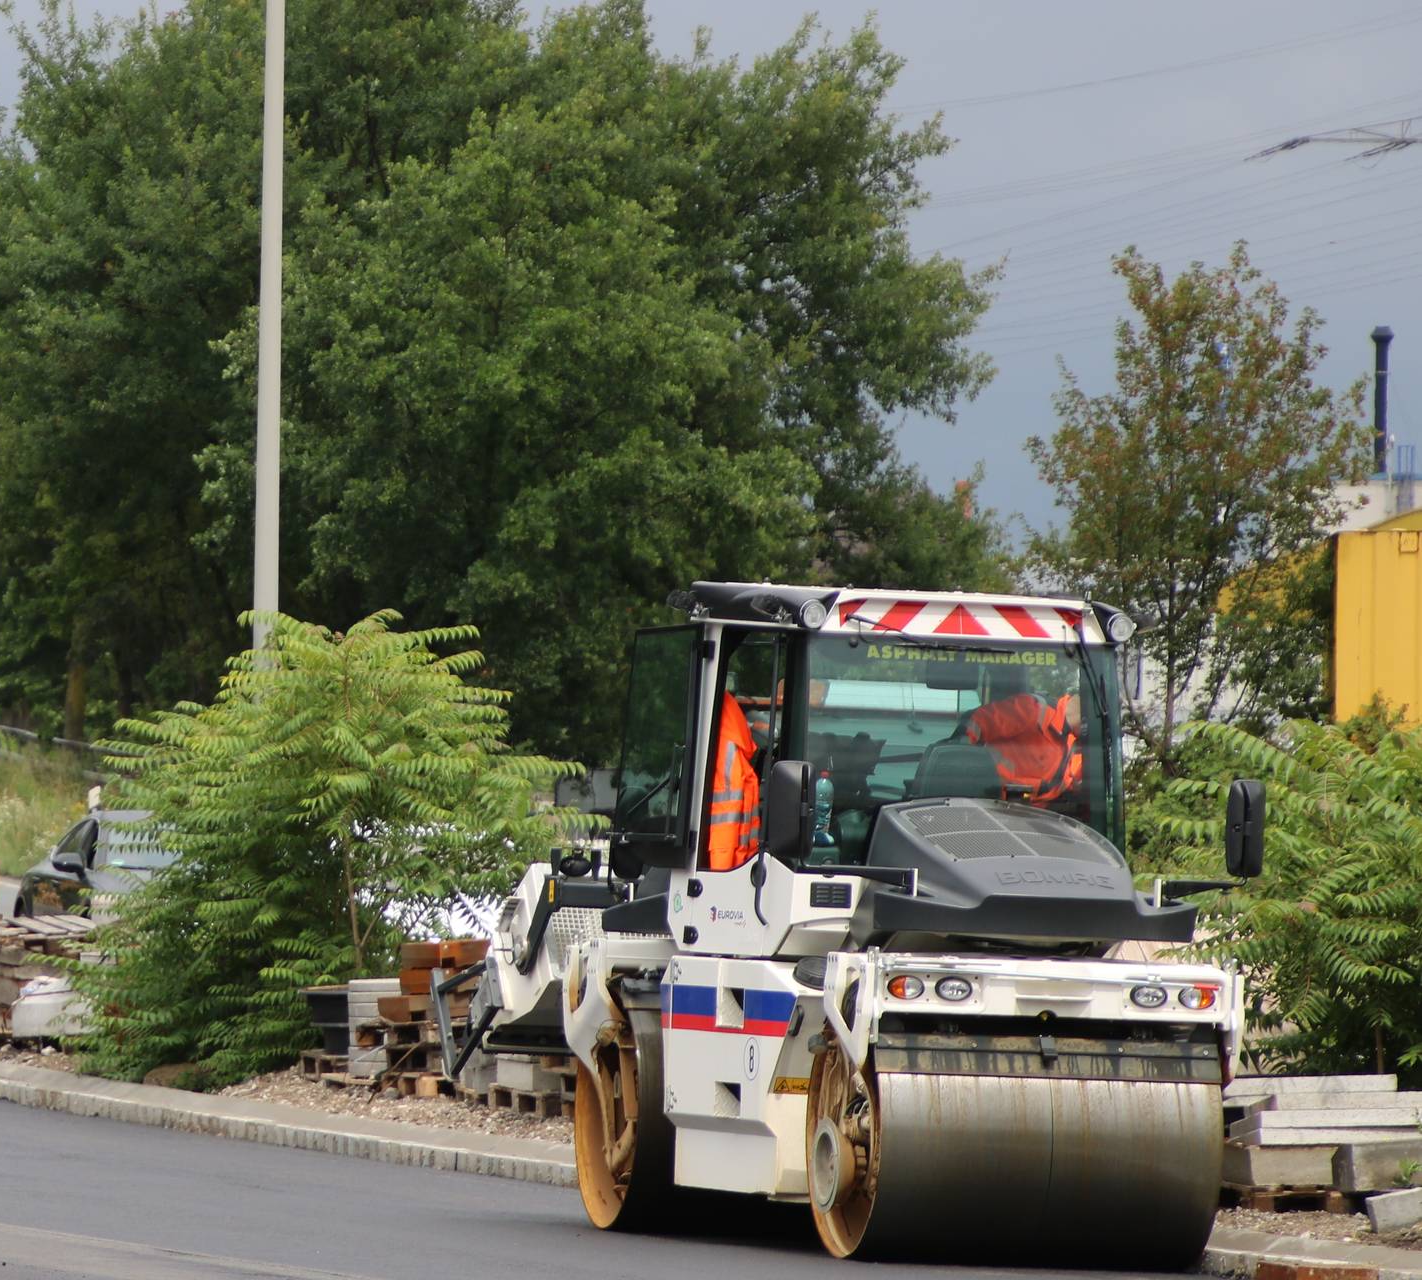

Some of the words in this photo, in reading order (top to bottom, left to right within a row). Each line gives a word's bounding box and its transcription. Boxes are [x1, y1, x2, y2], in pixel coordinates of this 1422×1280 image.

[867, 645, 956, 662] ASPHALT
[965, 649, 1057, 666] MANAGER
[718, 910, 743, 920] EUROVIA
[749, 1045, 755, 1073] 8
